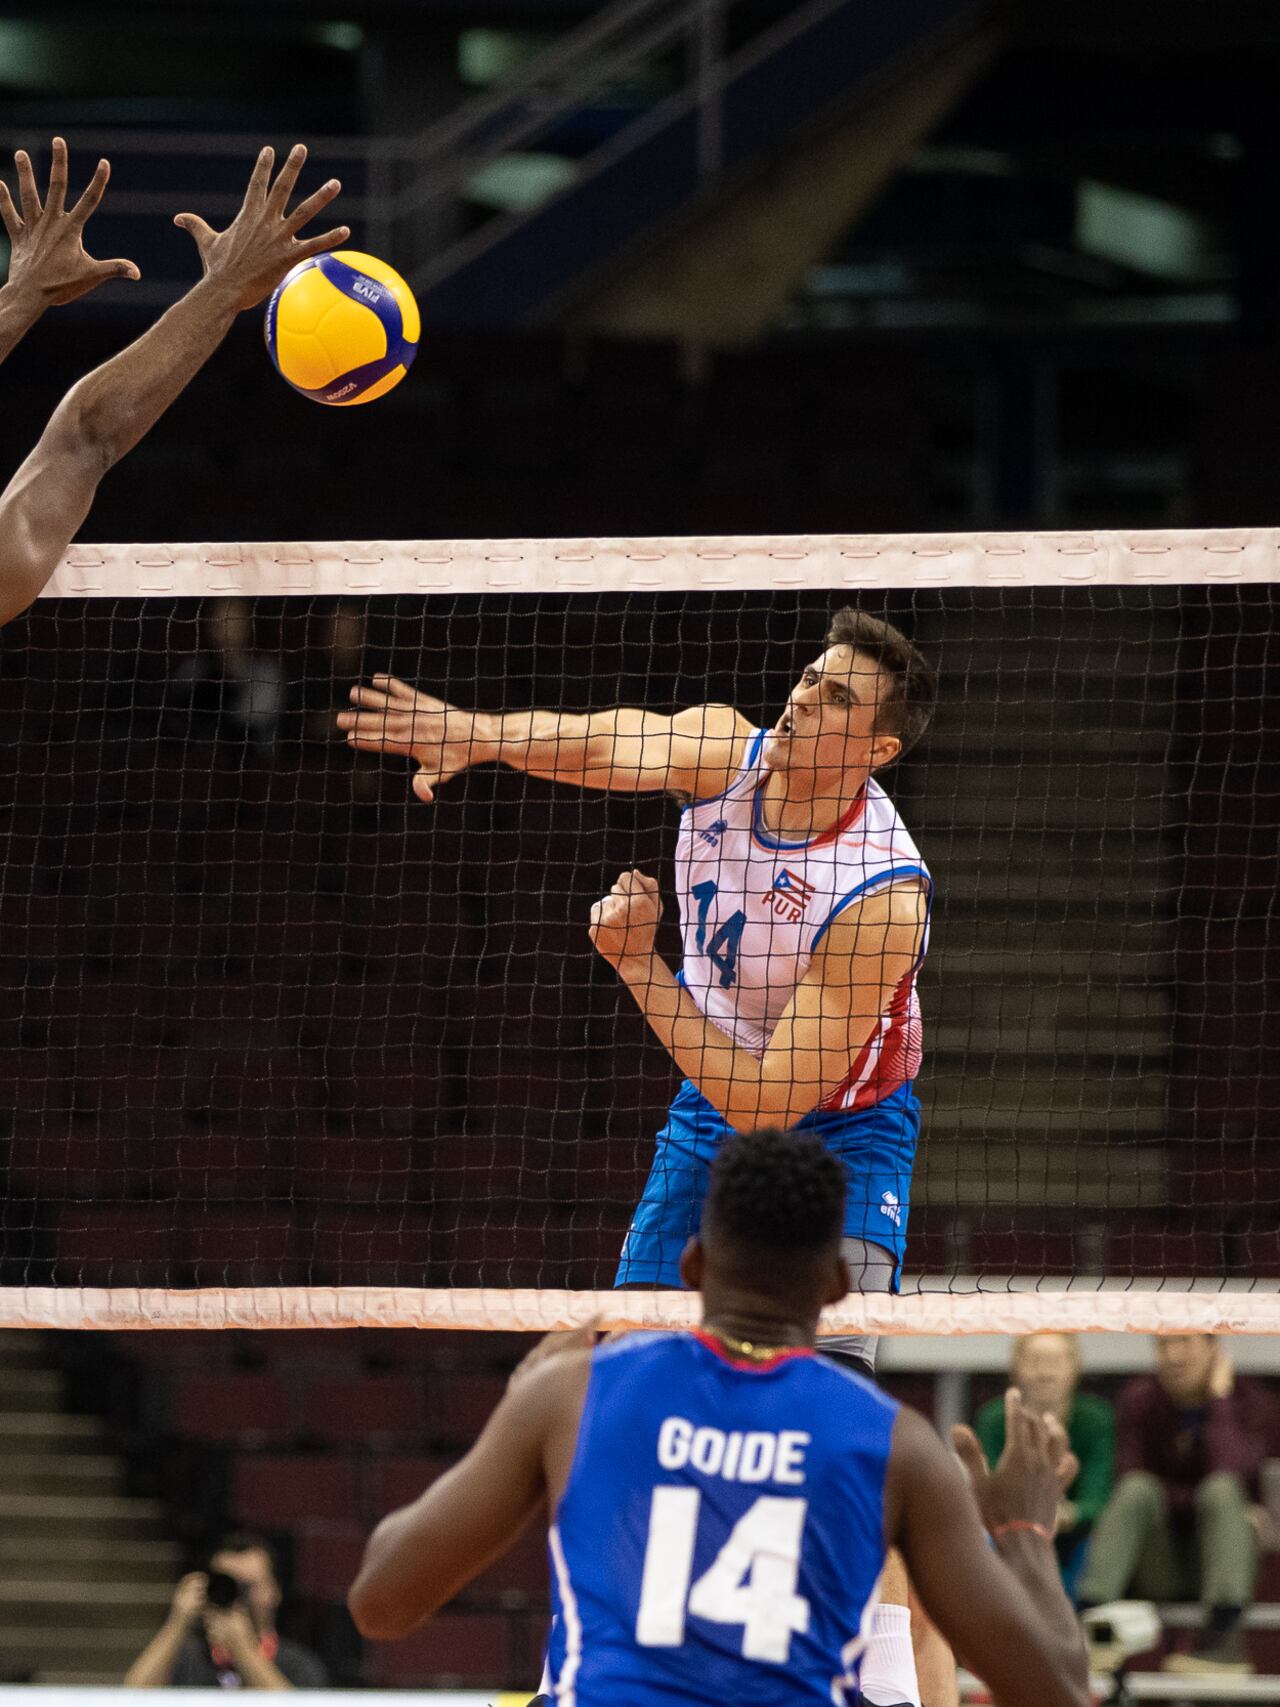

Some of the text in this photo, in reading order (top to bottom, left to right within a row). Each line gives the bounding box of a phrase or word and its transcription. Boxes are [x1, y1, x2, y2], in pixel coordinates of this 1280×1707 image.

[691, 879, 748, 990] 14
[760, 891, 803, 924] PUR
[657, 1416, 811, 1484] GOIDE
[635, 1485, 811, 1665] 14
